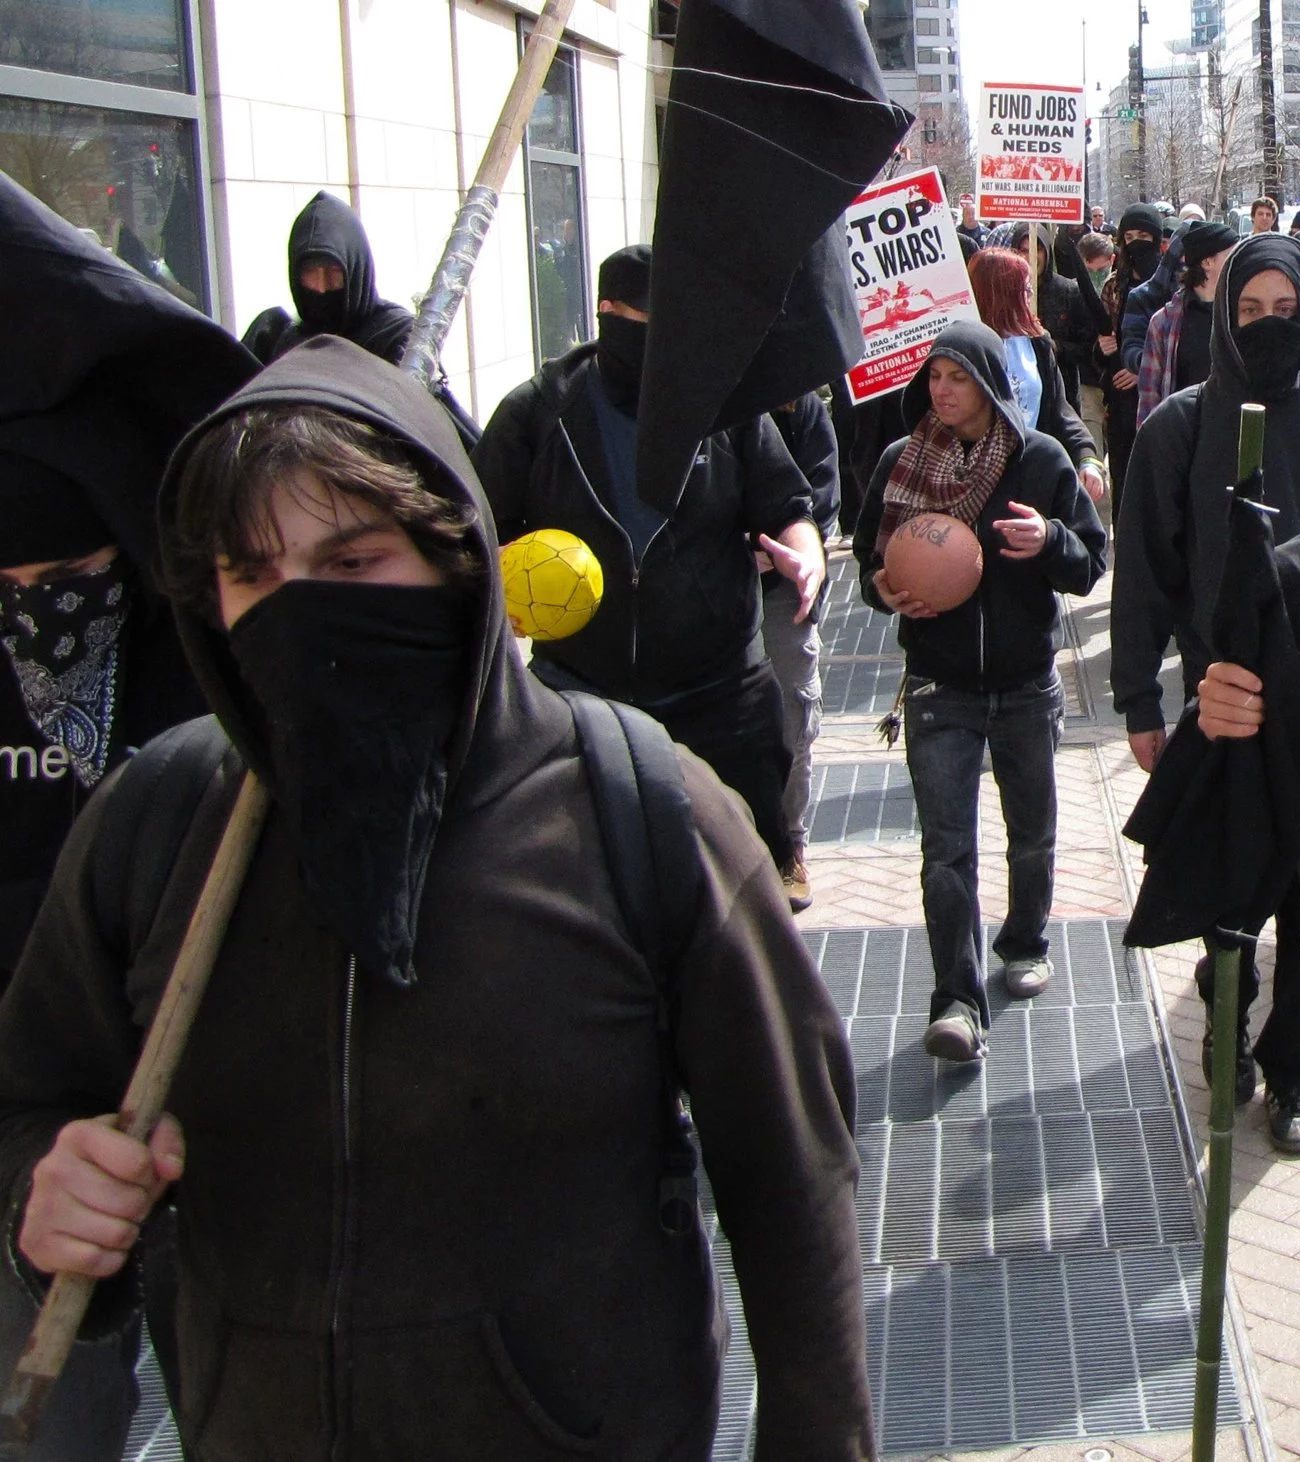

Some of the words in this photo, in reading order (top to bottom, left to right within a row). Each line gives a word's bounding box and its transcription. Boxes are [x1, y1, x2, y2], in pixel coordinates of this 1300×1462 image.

[989, 93, 1032, 119] FUND
[1036, 95, 1077, 122] JOBS
[991, 122, 1004, 136] &
[1008, 123, 1074, 138] HUMAN
[1002, 140, 1062, 154] NEEDS
[981, 182, 993, 190] NOT
[1014, 183, 1034, 192] BANKS
[1035, 184, 1040, 193] &
[992, 197, 1029, 206] NATIONAL
[1031, 200, 1069, 208] ASSEMBLY
[846, 198, 933, 248] TOP
[874, 226, 946, 279] WARS!
[870, 337, 889, 349] IRAQ
[894, 316, 948, 340] AFGHANISTAN
[861, 341, 899, 360] ALESTINE
[904, 333, 922, 345] IRAN
[866, 352, 914, 377] NATIONAL
